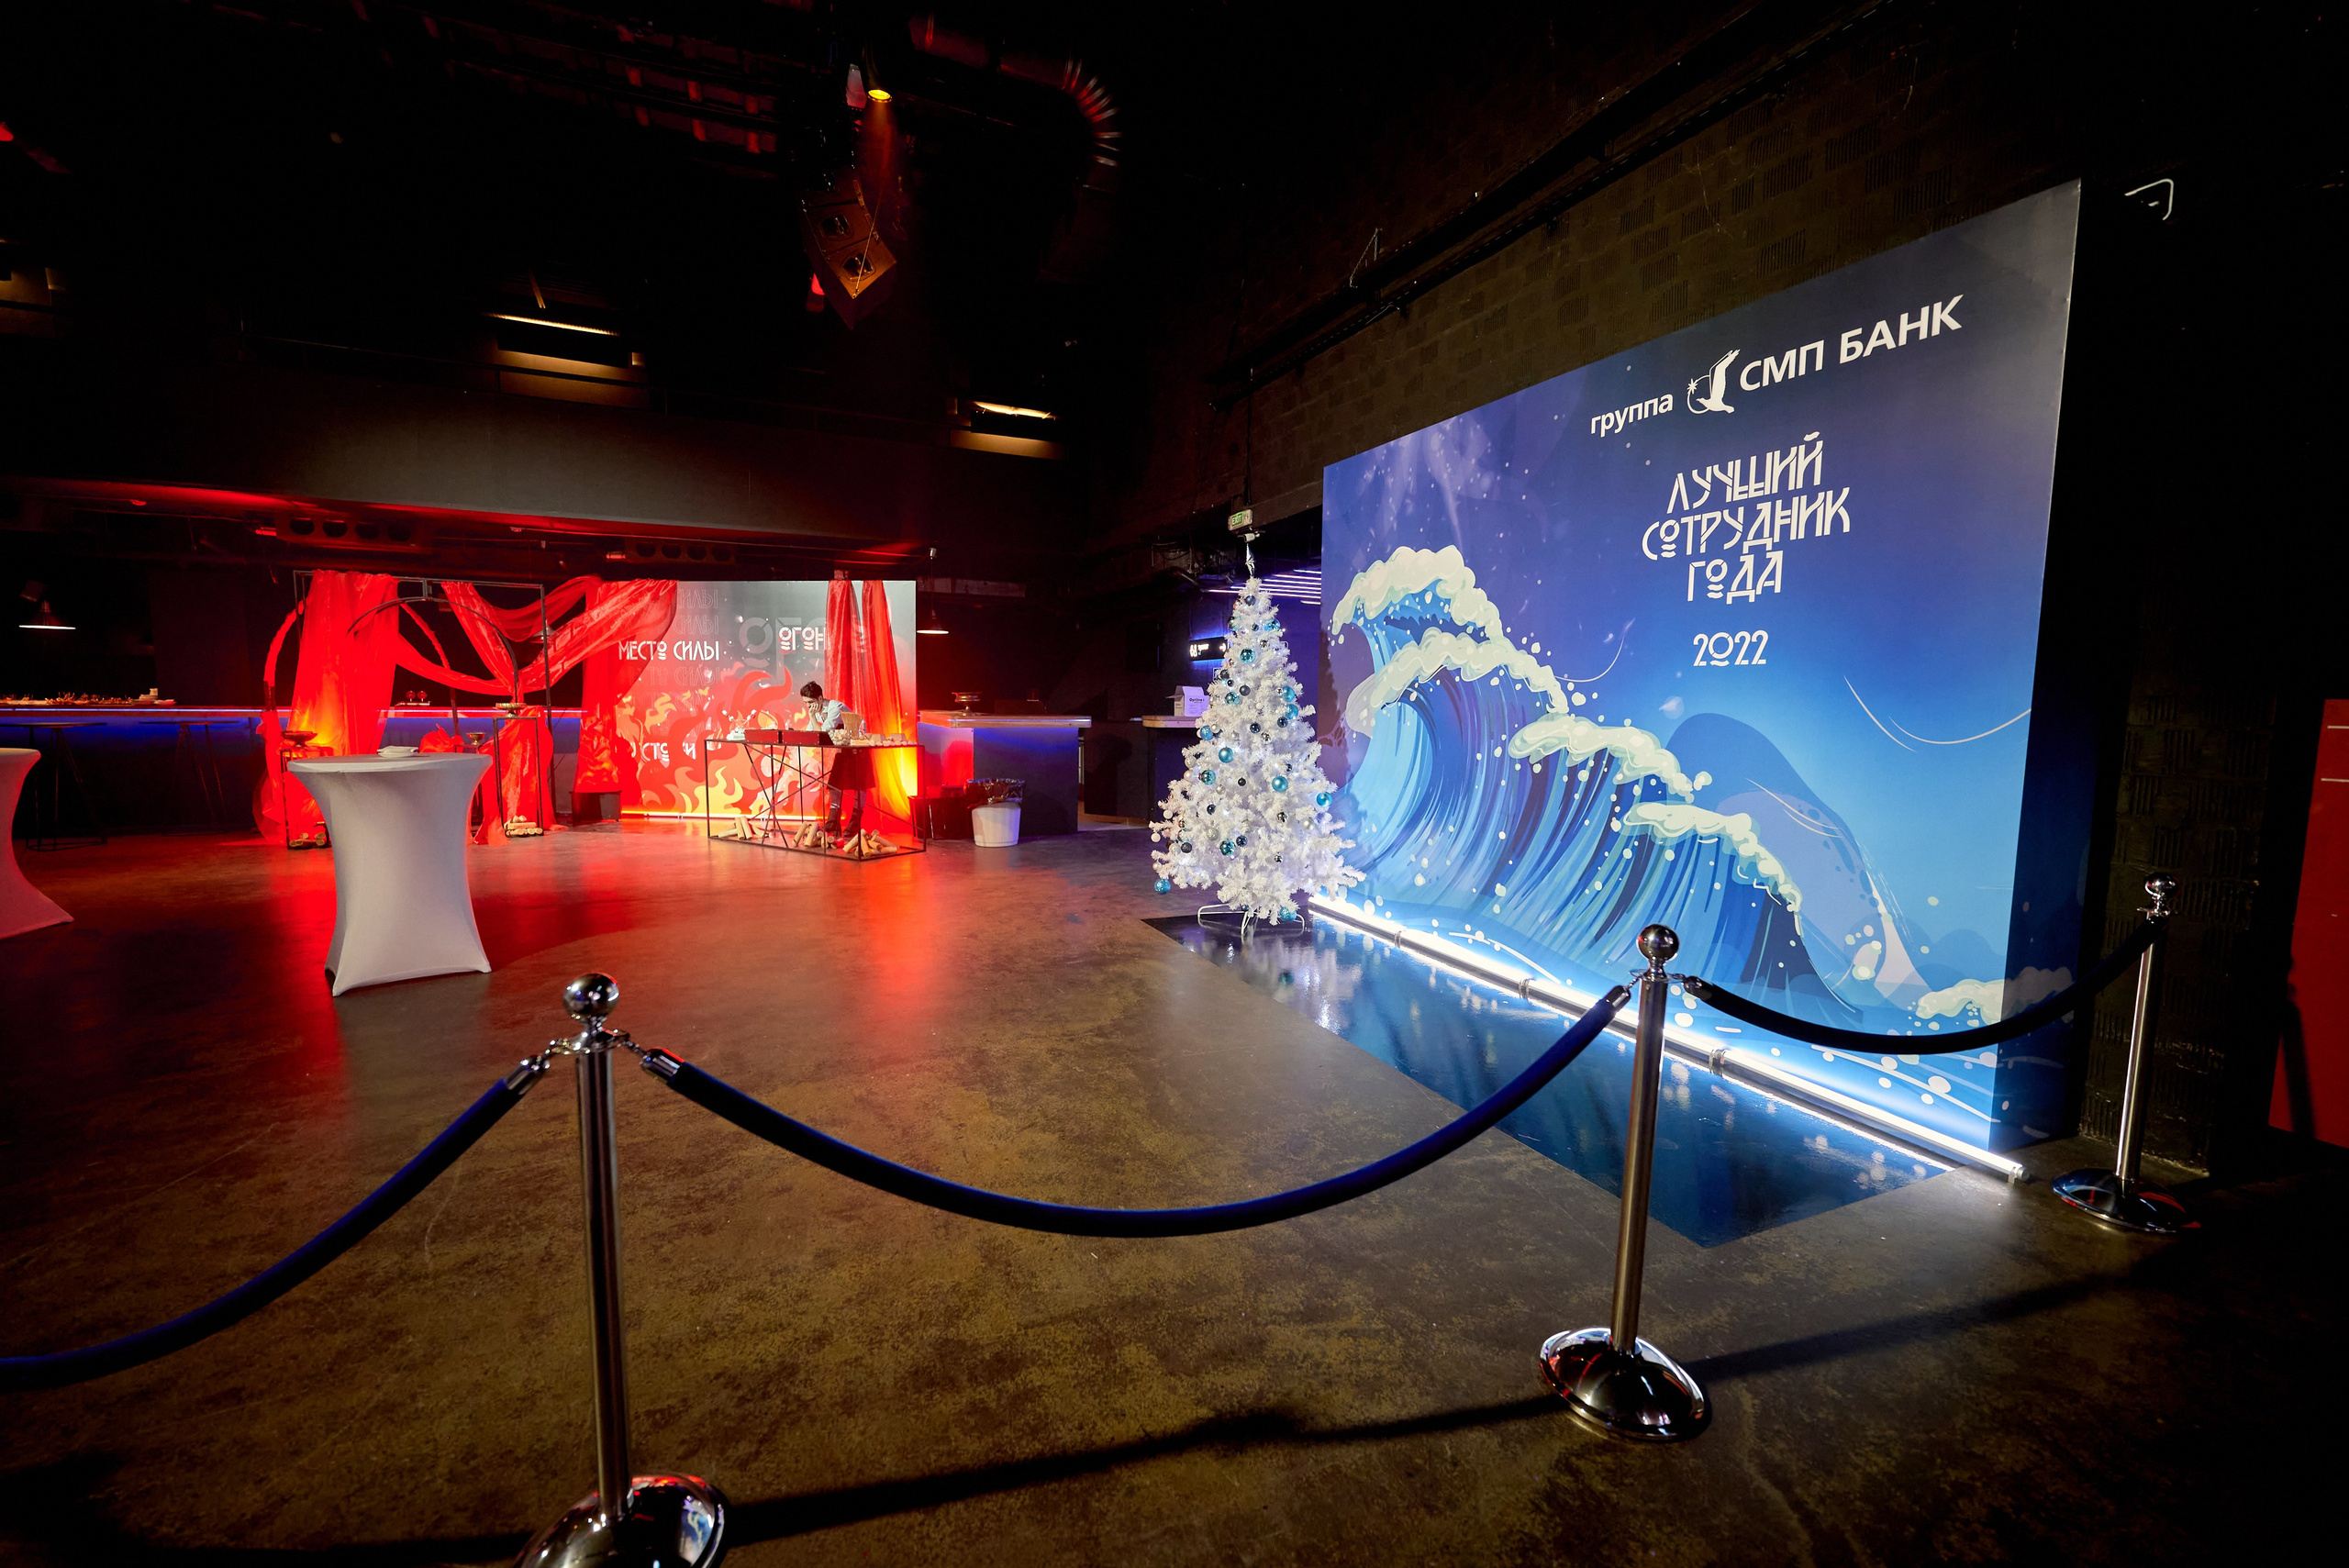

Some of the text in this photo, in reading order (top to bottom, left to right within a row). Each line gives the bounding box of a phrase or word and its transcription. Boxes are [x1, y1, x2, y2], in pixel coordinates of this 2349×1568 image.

[1590, 294, 1965, 438] группа СМП БАНК
[1666, 430, 1824, 515] ЛУЧШИЙ
[1642, 486, 1851, 562] СОТРУДНИК
[1687, 550, 1784, 605] ГОДА
[618, 640, 720, 661] МЕСТО СИЛЫ
[1692, 629, 1770, 667] 2022
